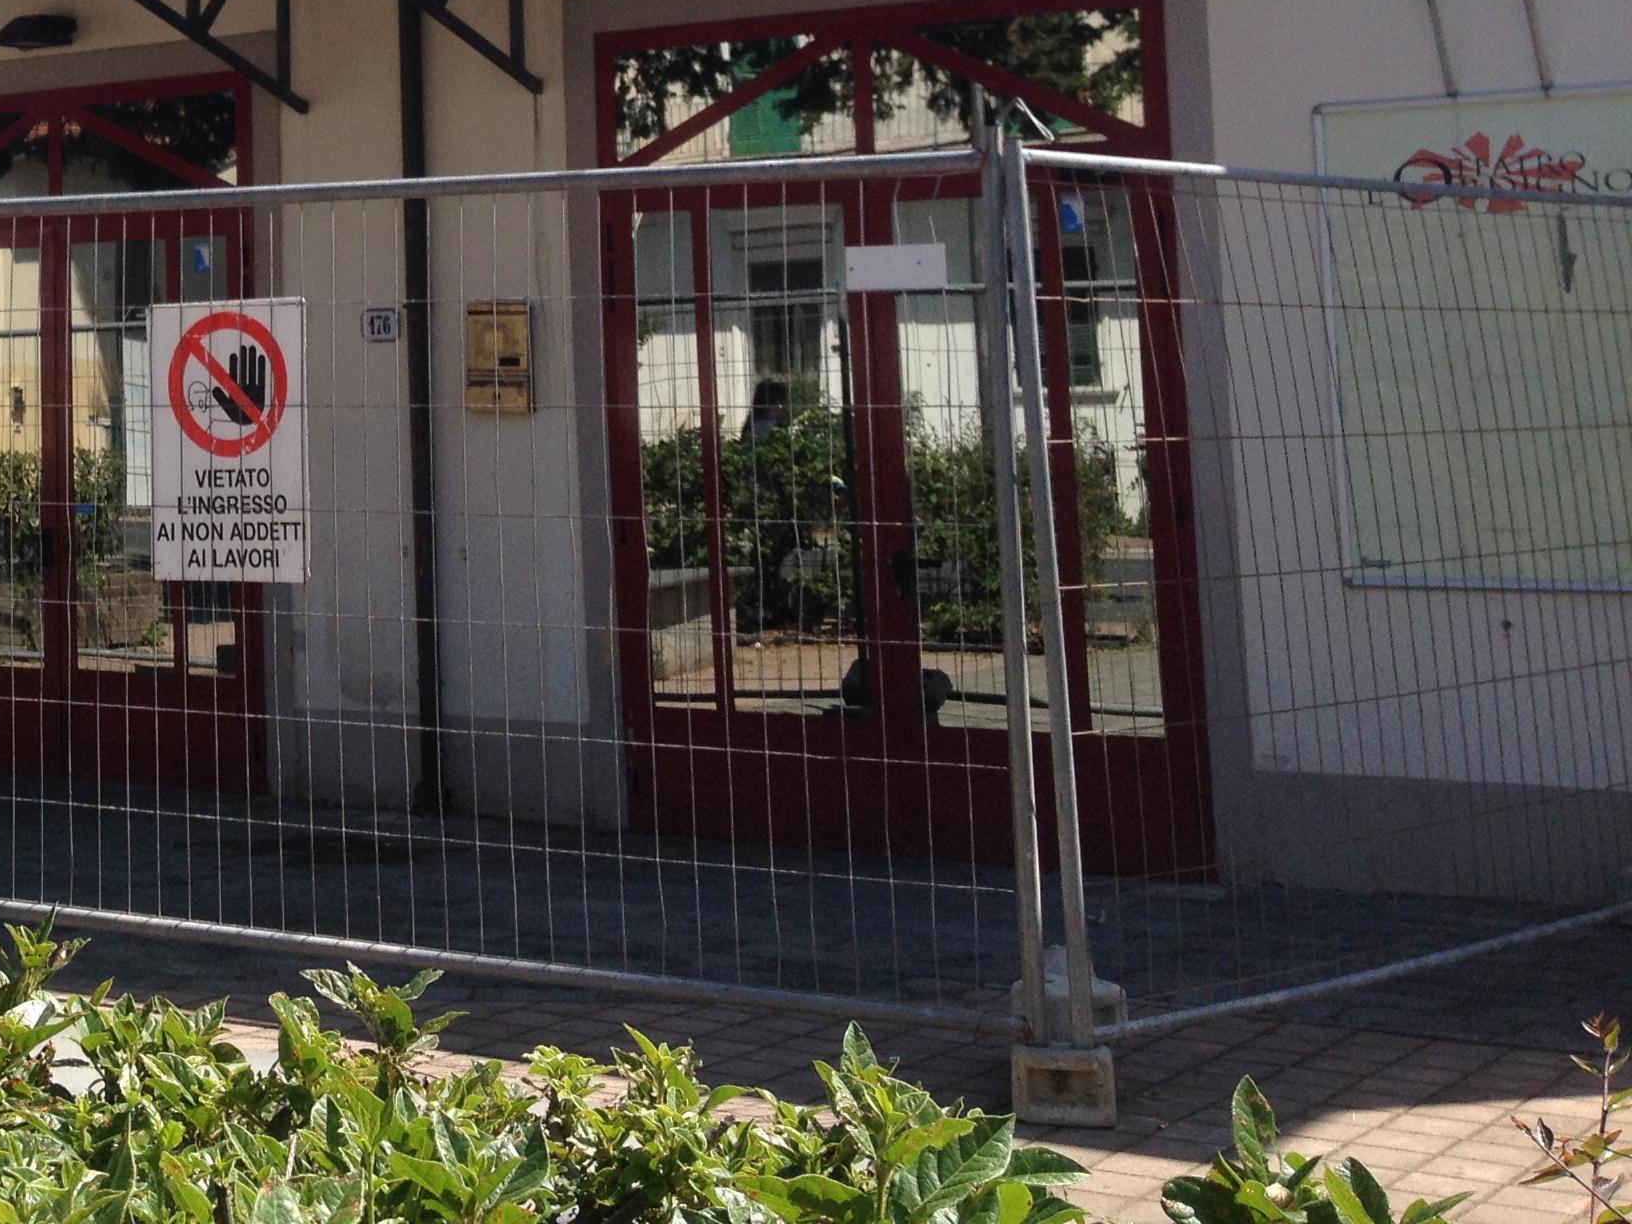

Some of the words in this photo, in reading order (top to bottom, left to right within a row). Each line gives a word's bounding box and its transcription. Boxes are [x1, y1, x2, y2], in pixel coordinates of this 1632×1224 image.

[369, 314, 391, 335] 176
[194, 467, 270, 489] VIETATO
[177, 494, 287, 515] L'INGRESSO
[156, 522, 175, 542] AI
[182, 522, 224, 542] NON
[229, 521, 306, 542] ADDETTI
[187, 548, 206, 568] AI
[212, 548, 280, 568] LAVORI
